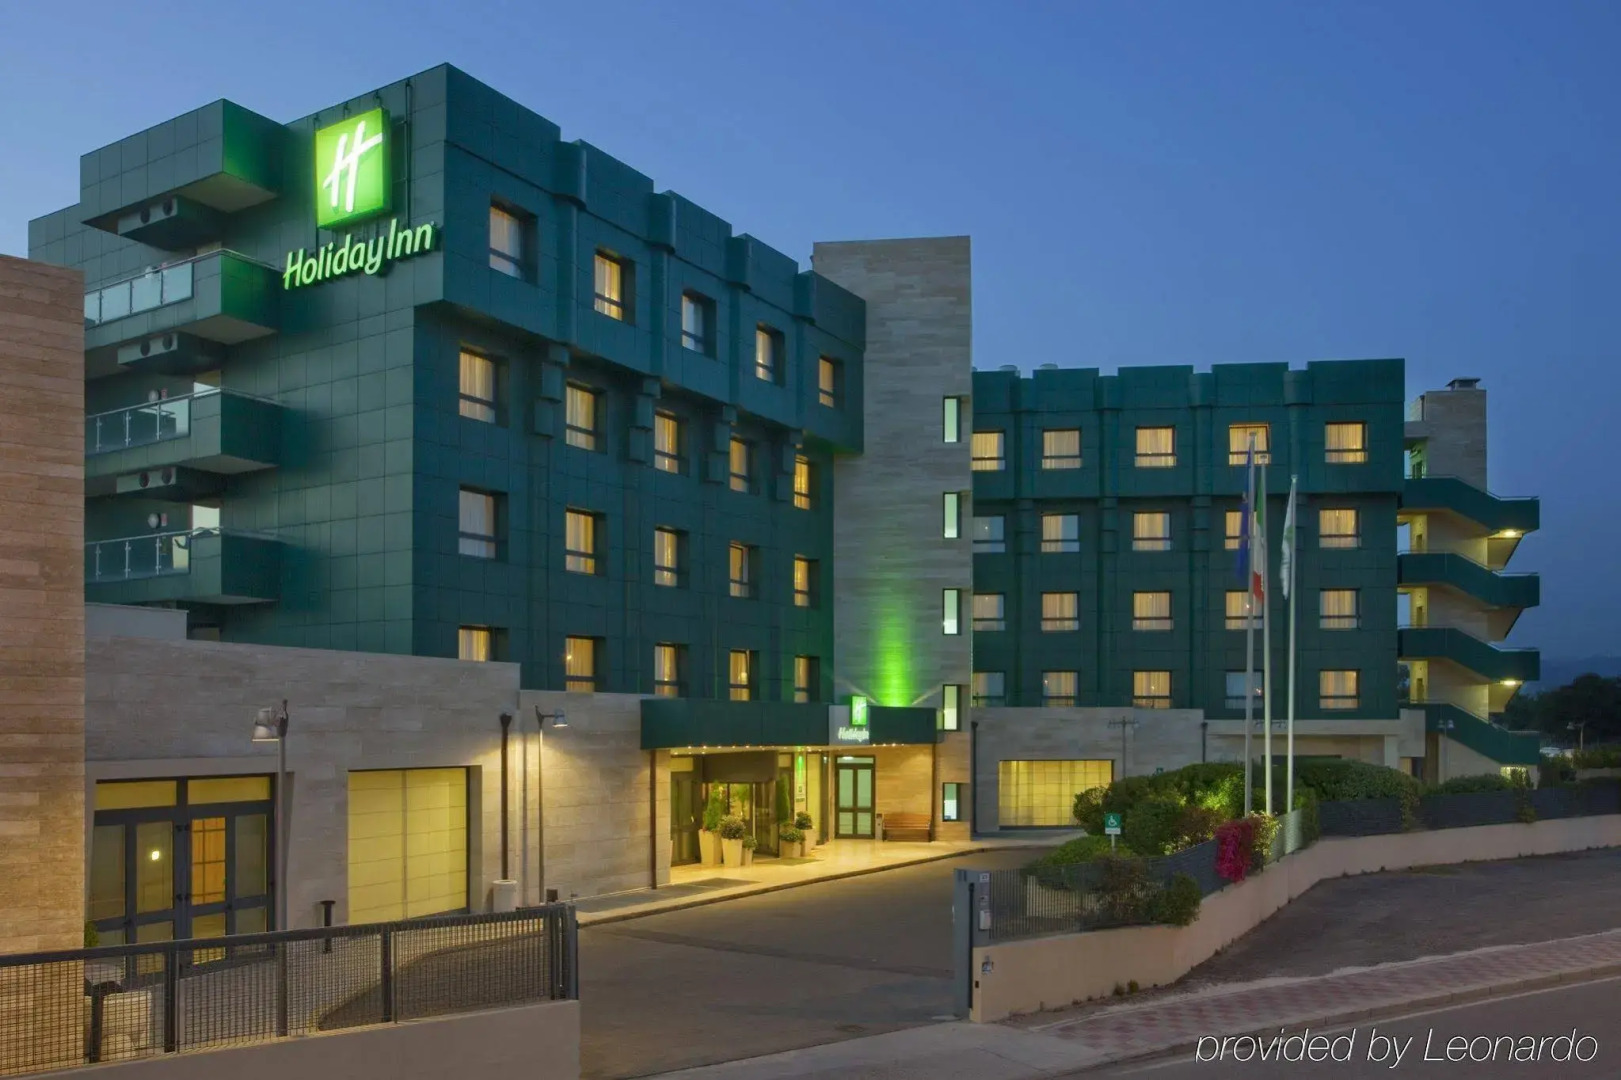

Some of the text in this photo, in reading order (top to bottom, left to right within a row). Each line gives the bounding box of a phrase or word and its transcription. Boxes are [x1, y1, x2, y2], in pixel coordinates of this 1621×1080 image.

[323, 120, 383, 213] H
[283, 218, 433, 290] Holiday Inn
